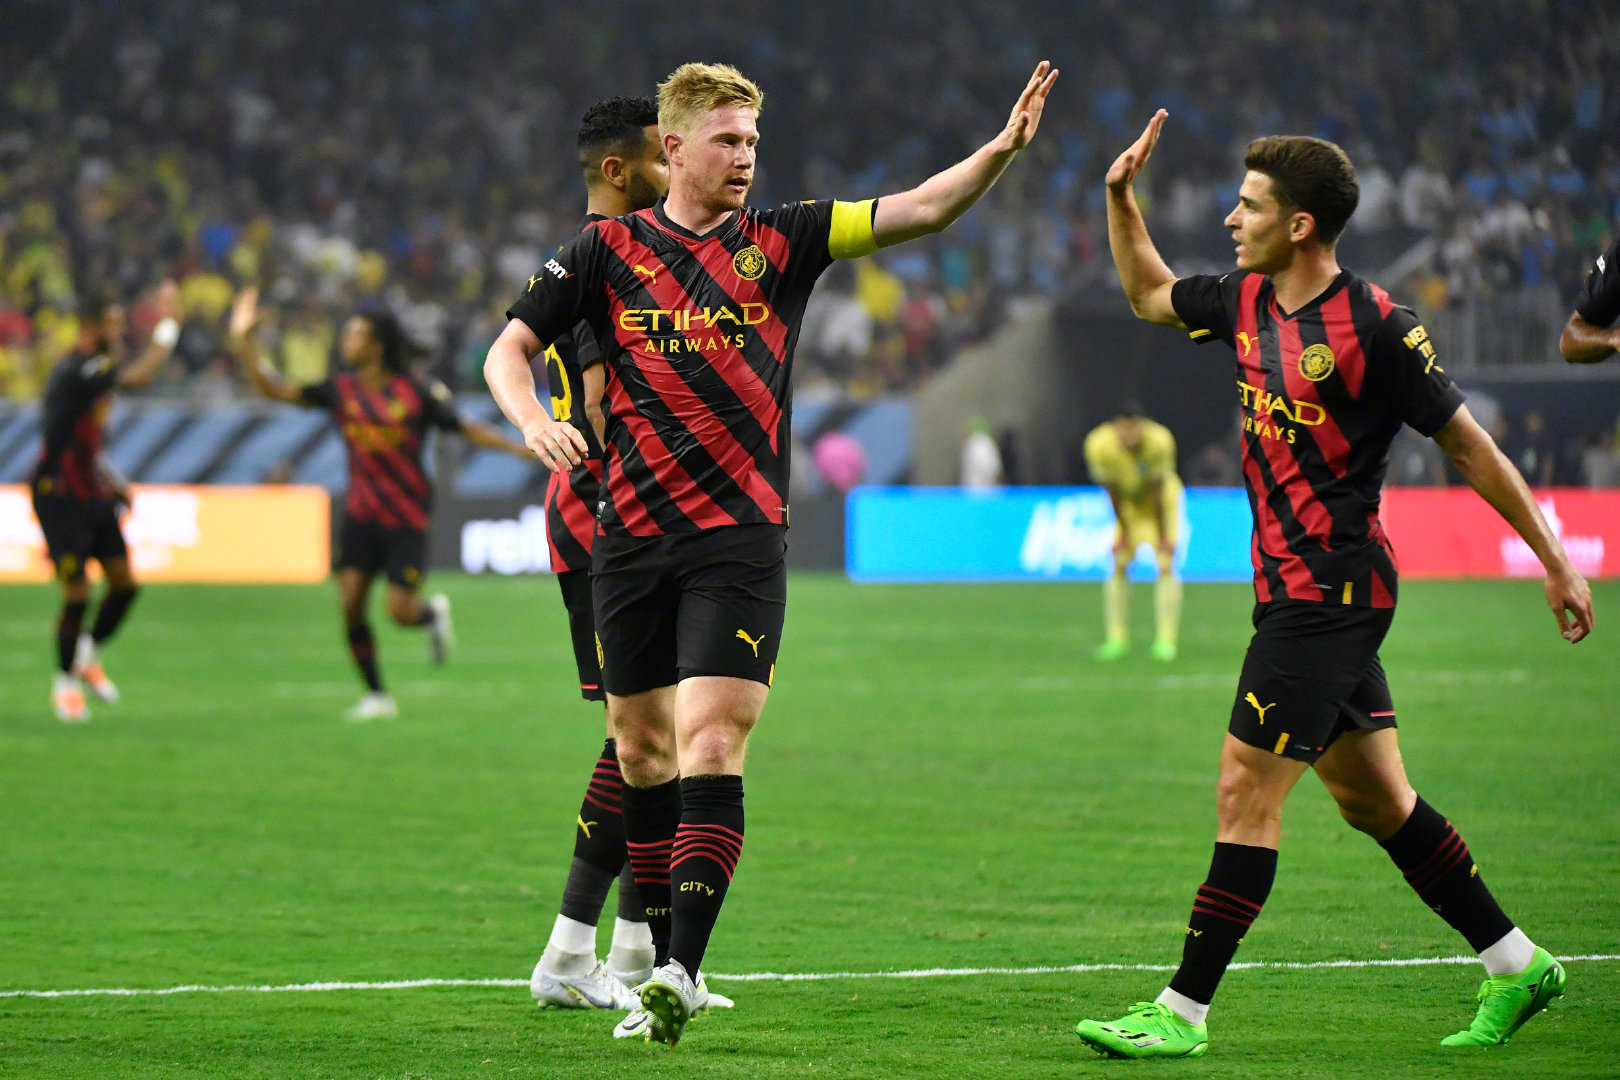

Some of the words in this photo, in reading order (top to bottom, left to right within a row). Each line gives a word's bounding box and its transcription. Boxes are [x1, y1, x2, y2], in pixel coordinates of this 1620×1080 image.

[619, 302, 770, 331] ETIHAD
[644, 333, 745, 353] AIRWAYS
[1236, 380, 1327, 426] TIHAD
[680, 880, 715, 896] CITY
